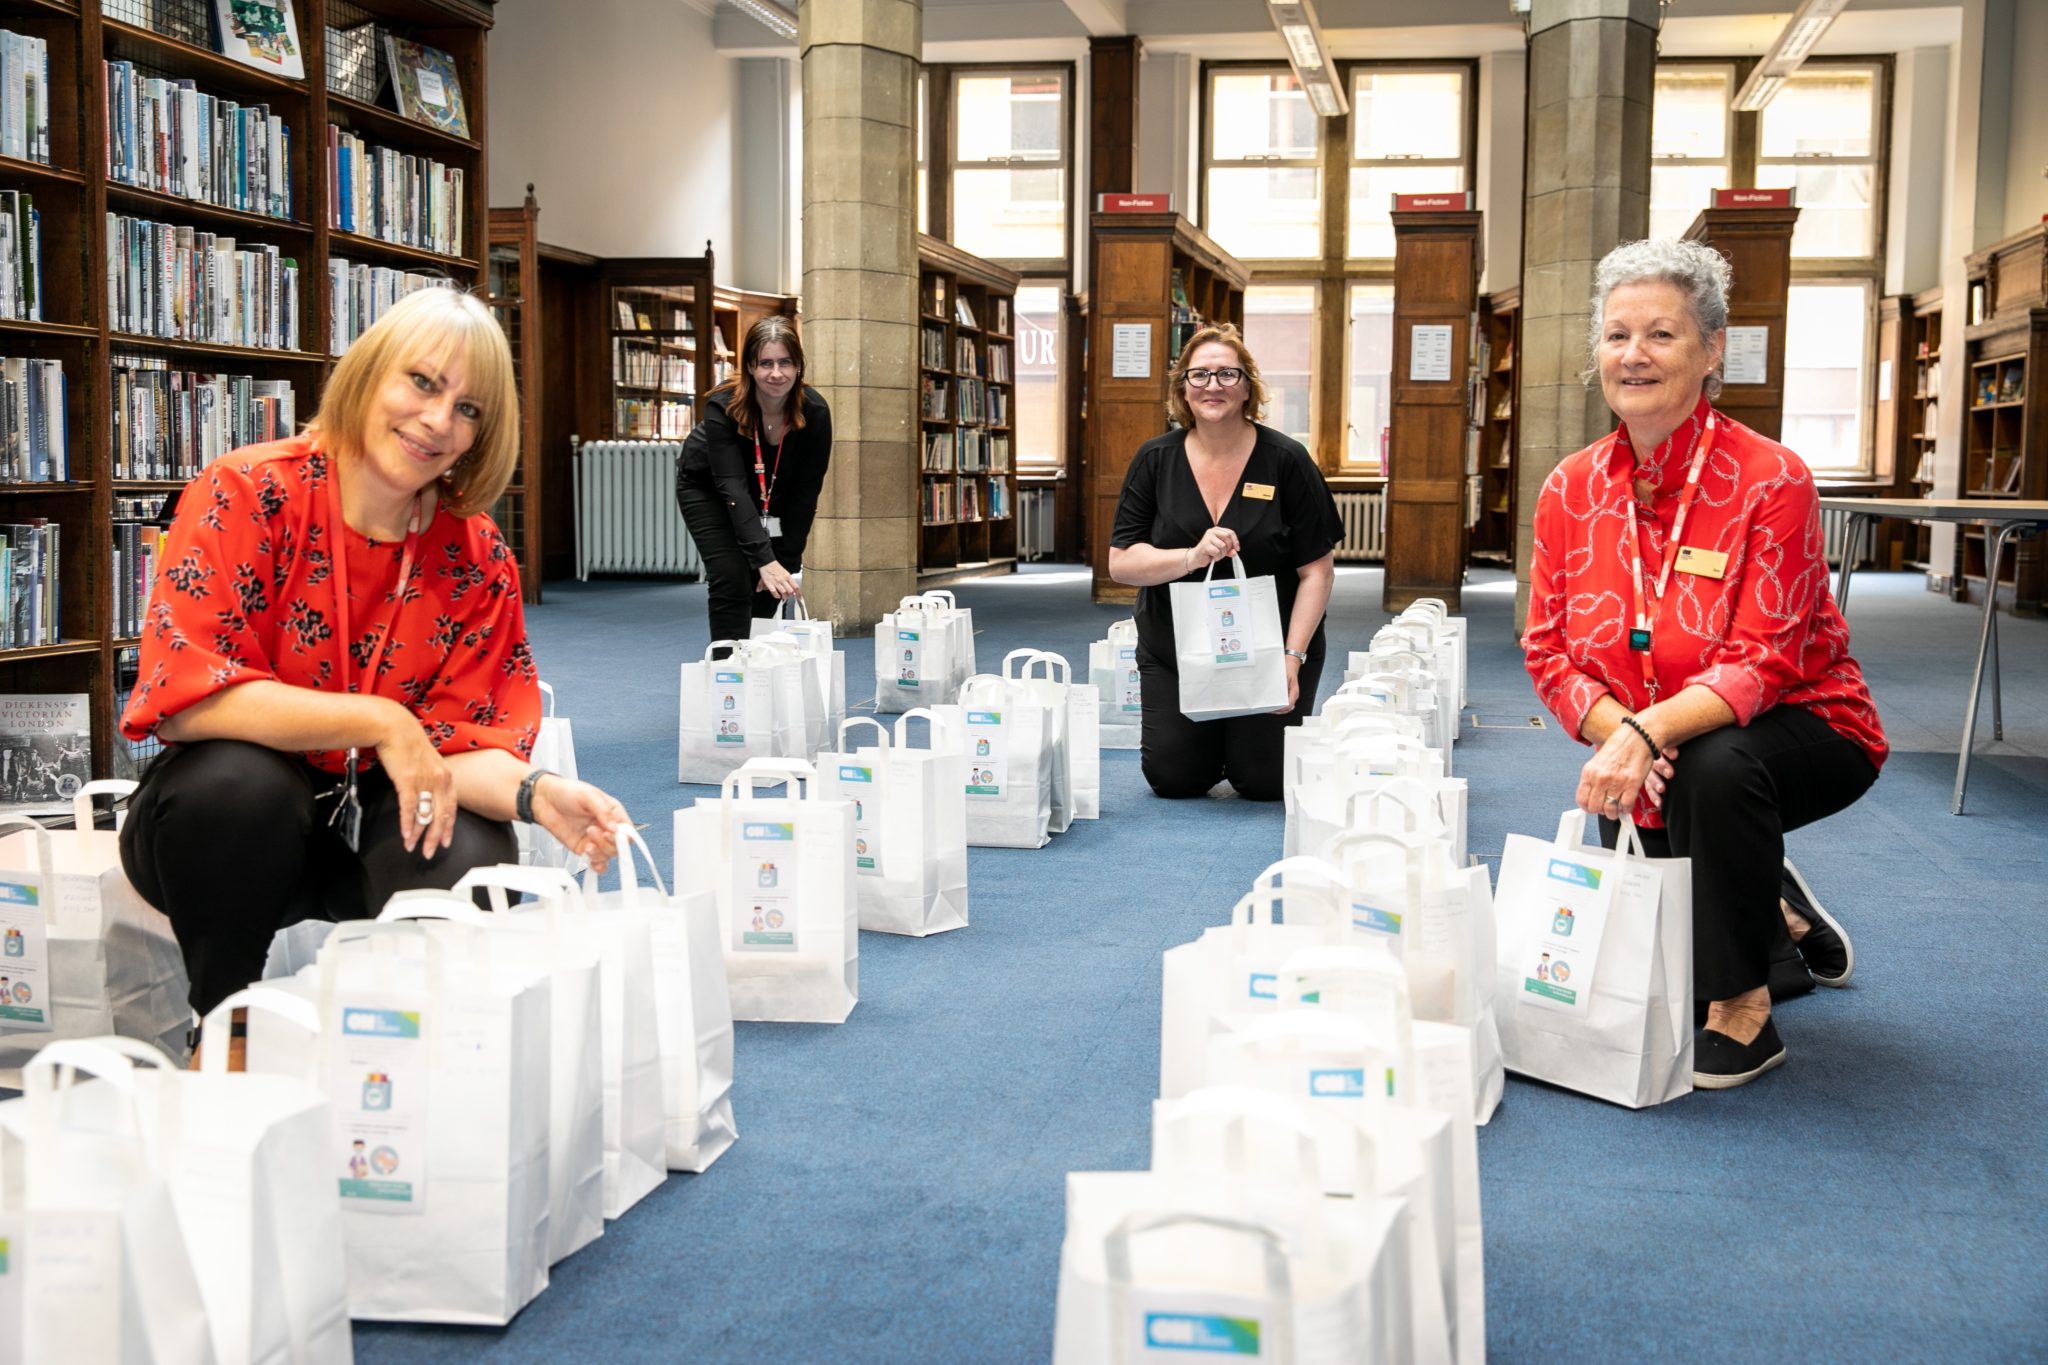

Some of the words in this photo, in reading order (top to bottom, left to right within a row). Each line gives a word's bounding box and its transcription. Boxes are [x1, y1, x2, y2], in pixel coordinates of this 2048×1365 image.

[1118, 199, 1154, 207] Non-Fiction
[1412, 198, 1451, 206] Non-Fiction
[5, 701, 69, 709] DICKENS'S
[1, 710, 73, 718] VICTORIAN
[10, 720, 65, 728] LONDON
